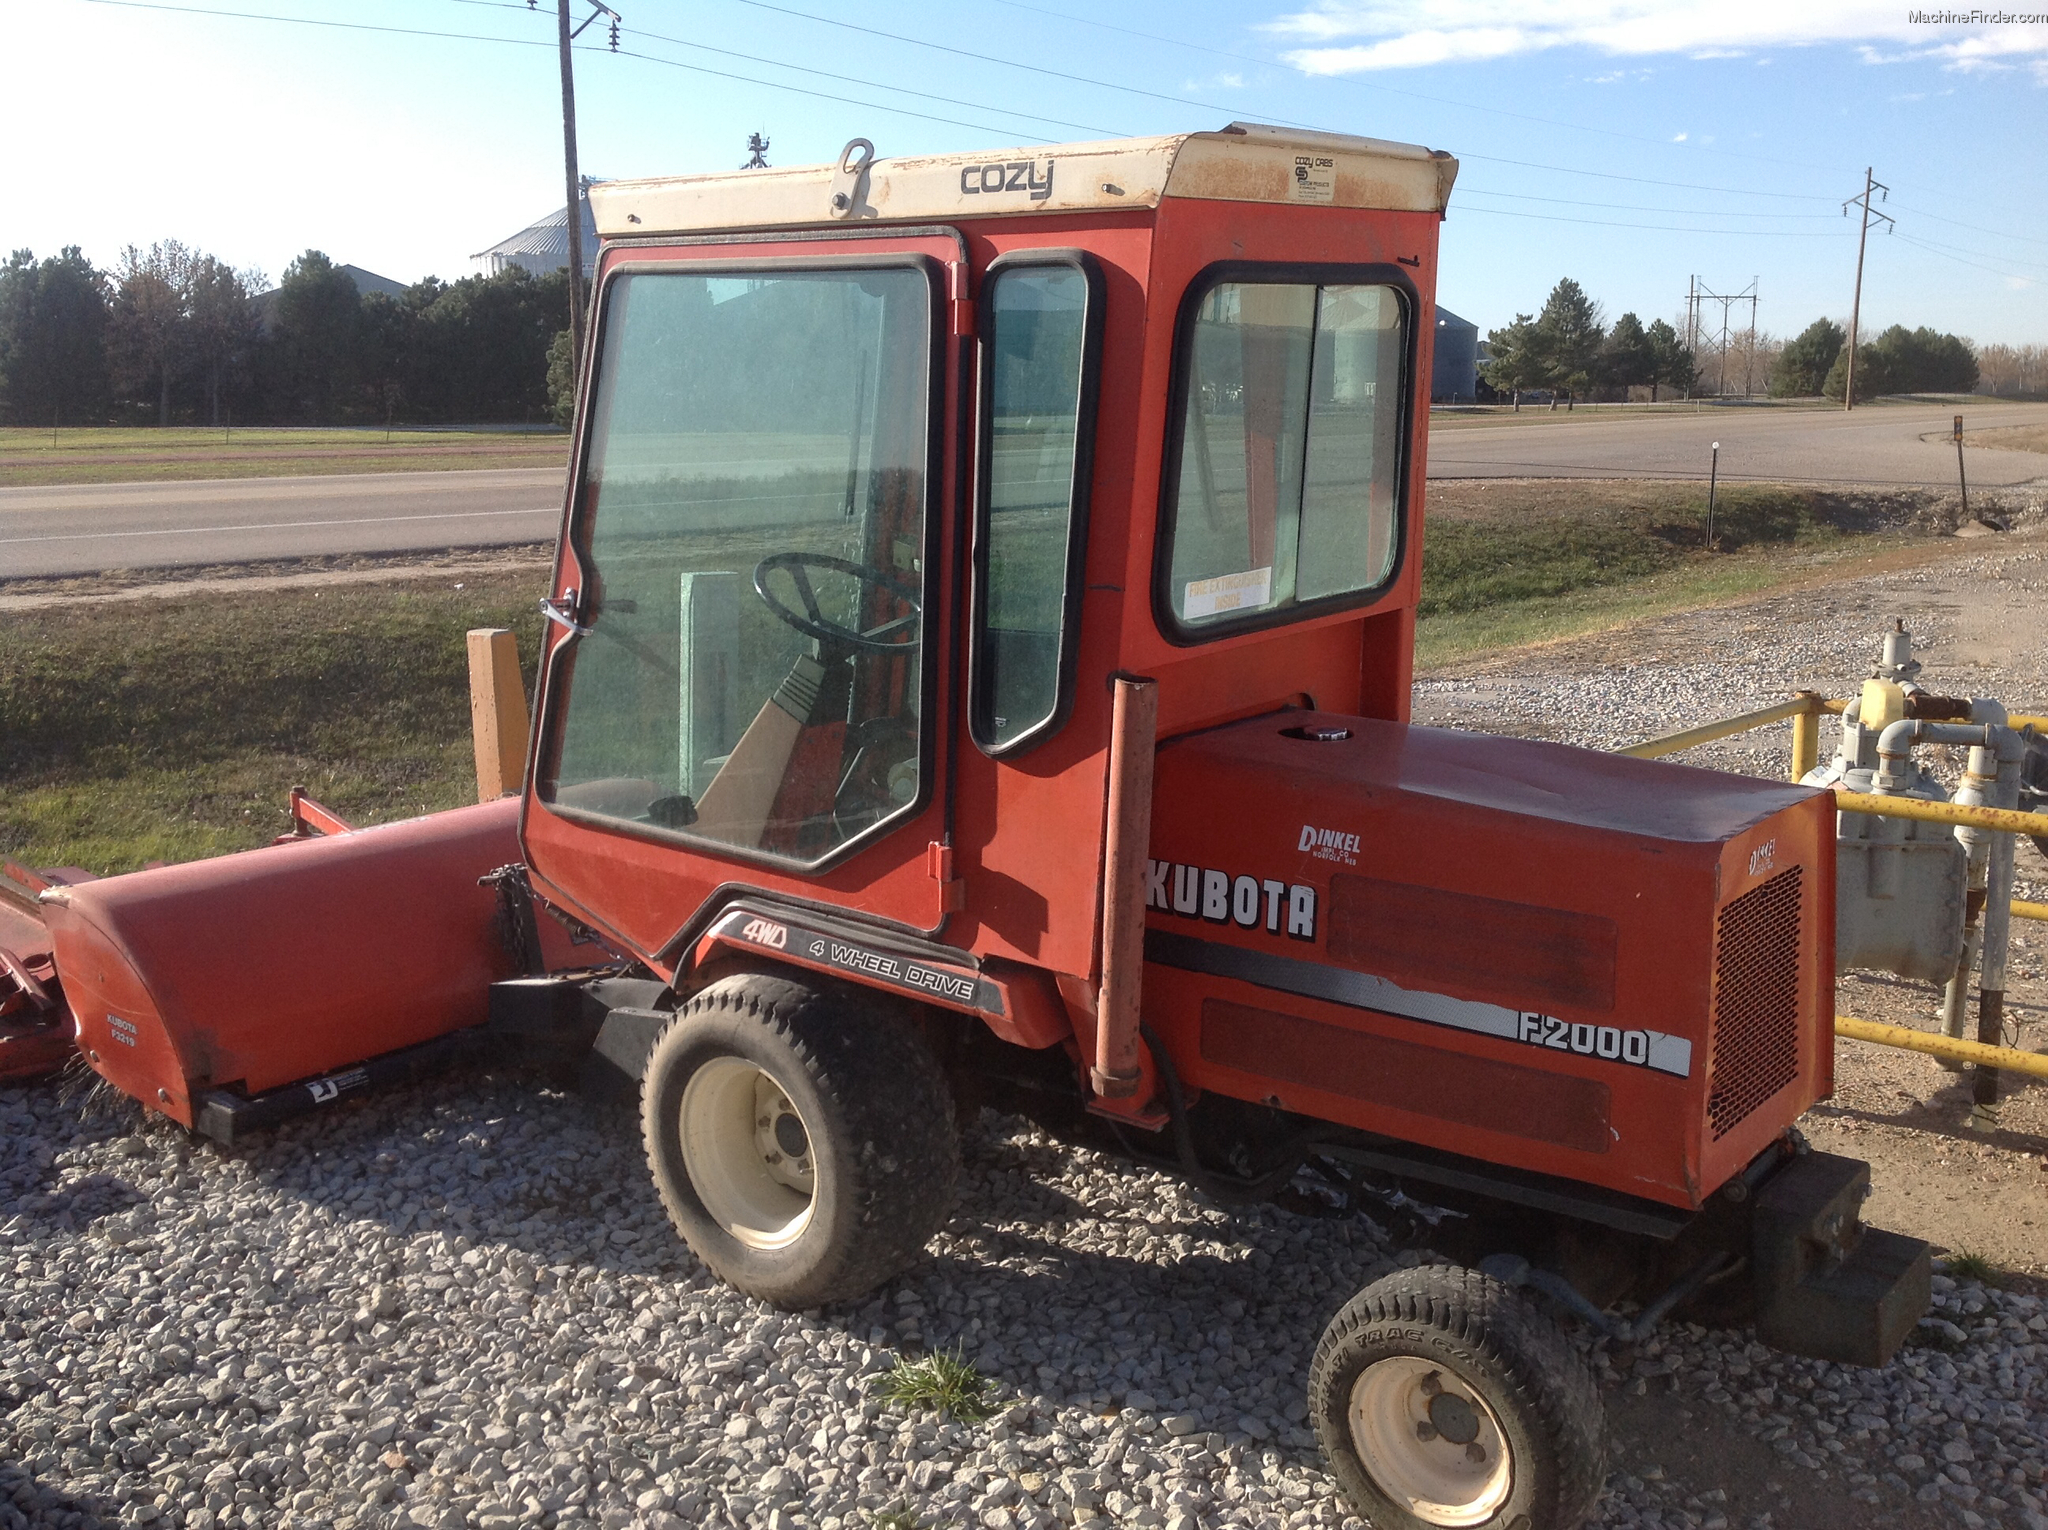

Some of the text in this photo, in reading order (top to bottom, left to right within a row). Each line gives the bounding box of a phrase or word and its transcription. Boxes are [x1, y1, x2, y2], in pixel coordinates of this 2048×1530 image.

[1298, 825, 1360, 853] DINKEL
[1312, 851, 1340, 862] NORFOLK
[1147, 859, 1316, 938] KUBOTA
[743, 919, 788, 950] 4WD
[809, 940, 975, 1001] 4 WHEEL DRIVE
[106, 1013, 137, 1036] KUBOTA
[1354, 1328, 1424, 1348] TRAC
